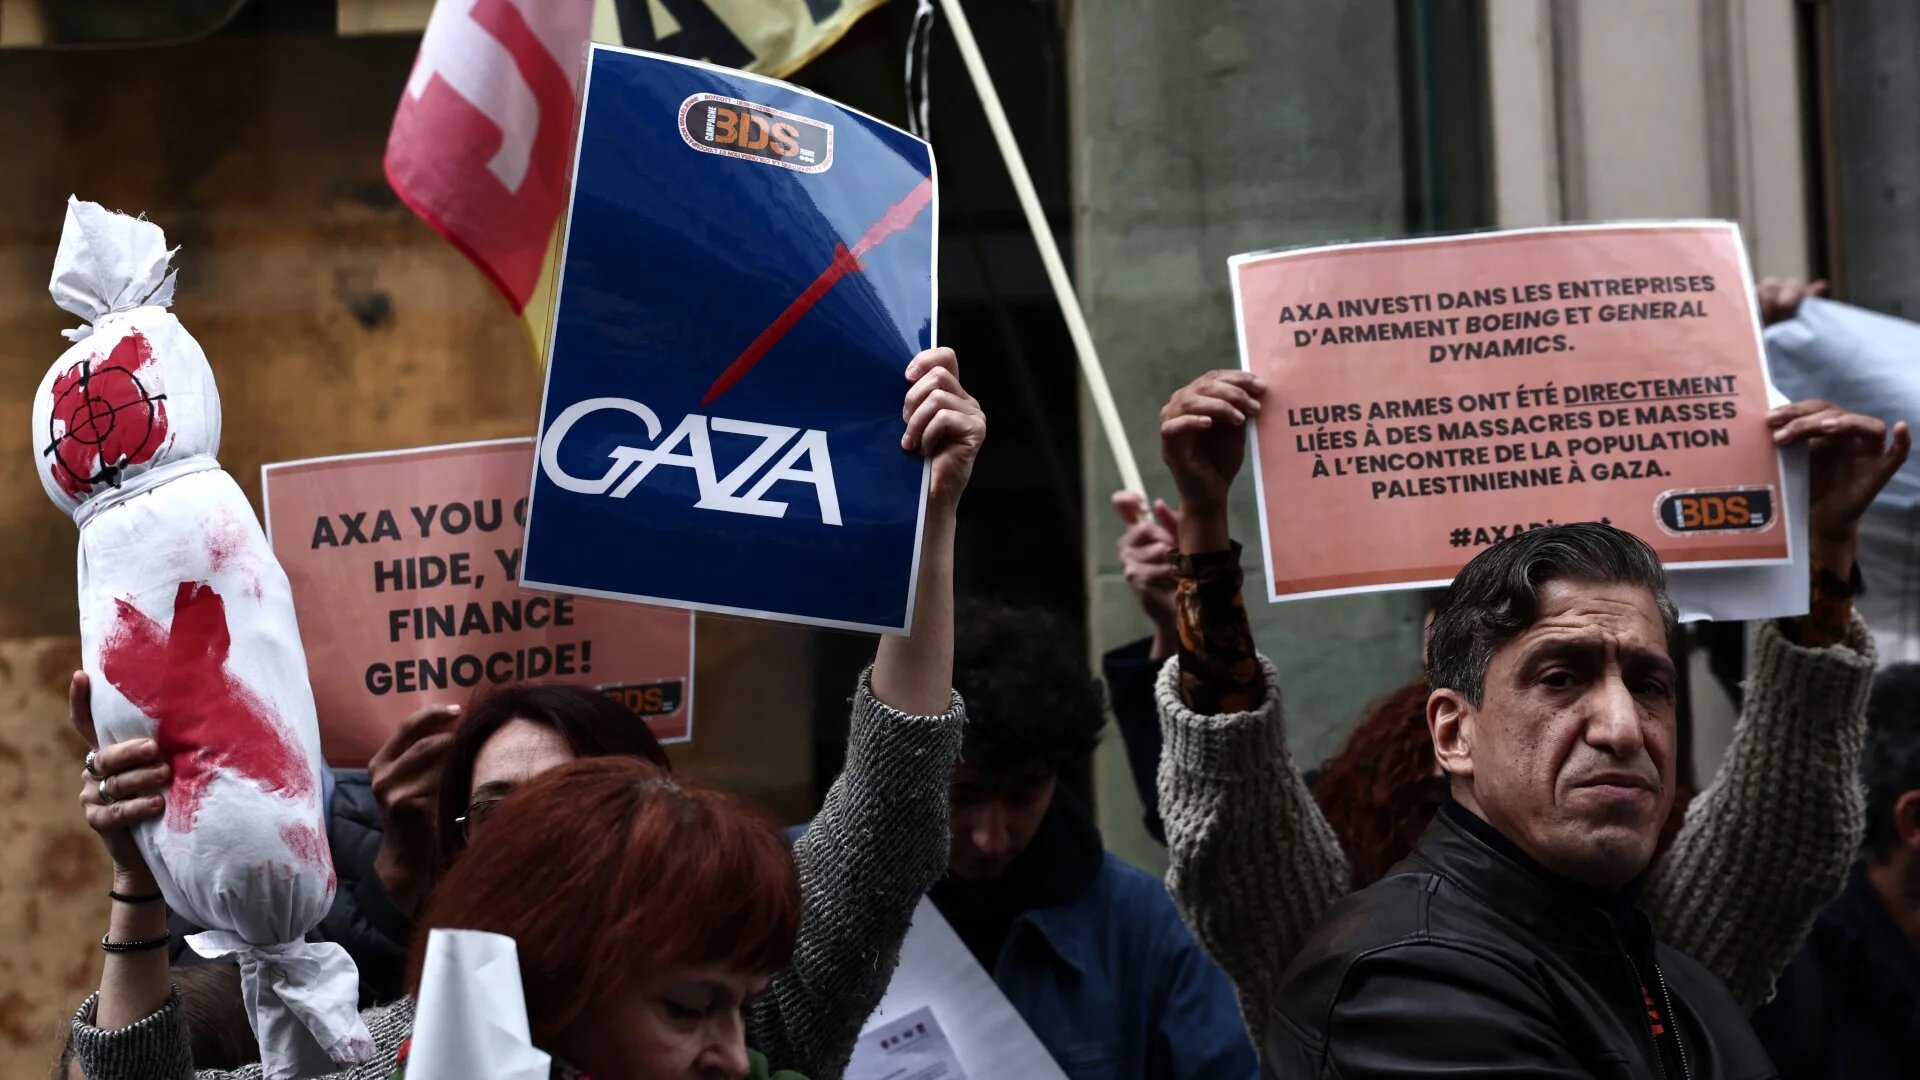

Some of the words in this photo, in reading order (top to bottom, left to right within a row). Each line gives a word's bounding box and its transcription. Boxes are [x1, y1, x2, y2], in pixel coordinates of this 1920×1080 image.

[704, 105, 717, 142] CAMPAGNE
[1279, 303, 1333, 324] AXA
[1338, 294, 1432, 318] INVESTI
[1437, 288, 1507, 310] DANS
[1512, 283, 1553, 303] LES
[1558, 275, 1716, 300] ENTREPRISES
[1465, 309, 1560, 334] BOEING
[1565, 306, 1593, 325] ET
[1598, 300, 1708, 322] GENERAL
[1429, 334, 1575, 363] DYNAMICS.
[1288, 403, 1362, 427] LEURS
[1368, 396, 1453, 420] ARMES
[1458, 391, 1511, 412] ONT
[1516, 381, 1558, 408] ÉTÉ
[1564, 375, 1738, 406] DIRECTEMENT
[1295, 426, 1358, 453] LIÉES
[1364, 423, 1381, 448] À
[1386, 424, 1432, 446] DES
[1437, 411, 1593, 441] MASSACRES
[1598, 408, 1630, 428] DE
[1635, 401, 1737, 425] MASSES
[540, 397, 843, 526] GAZA
[1311, 454, 1330, 478] À
[1495, 443, 1527, 463] DE
[1531, 440, 1563, 460] LA
[1567, 428, 1729, 457] POPULATION
[1371, 466, 1563, 500] PALESTINIENNE
[1567, 460, 1586, 483] À
[1591, 459, 1672, 481] GAZA.
[311, 509, 402, 550] AXA
[410, 498, 503, 538] YOU
[374, 552, 485, 593] HIDE,
[389, 596, 575, 643] FINANCE
[365, 641, 593, 695] GENOCIDE!
